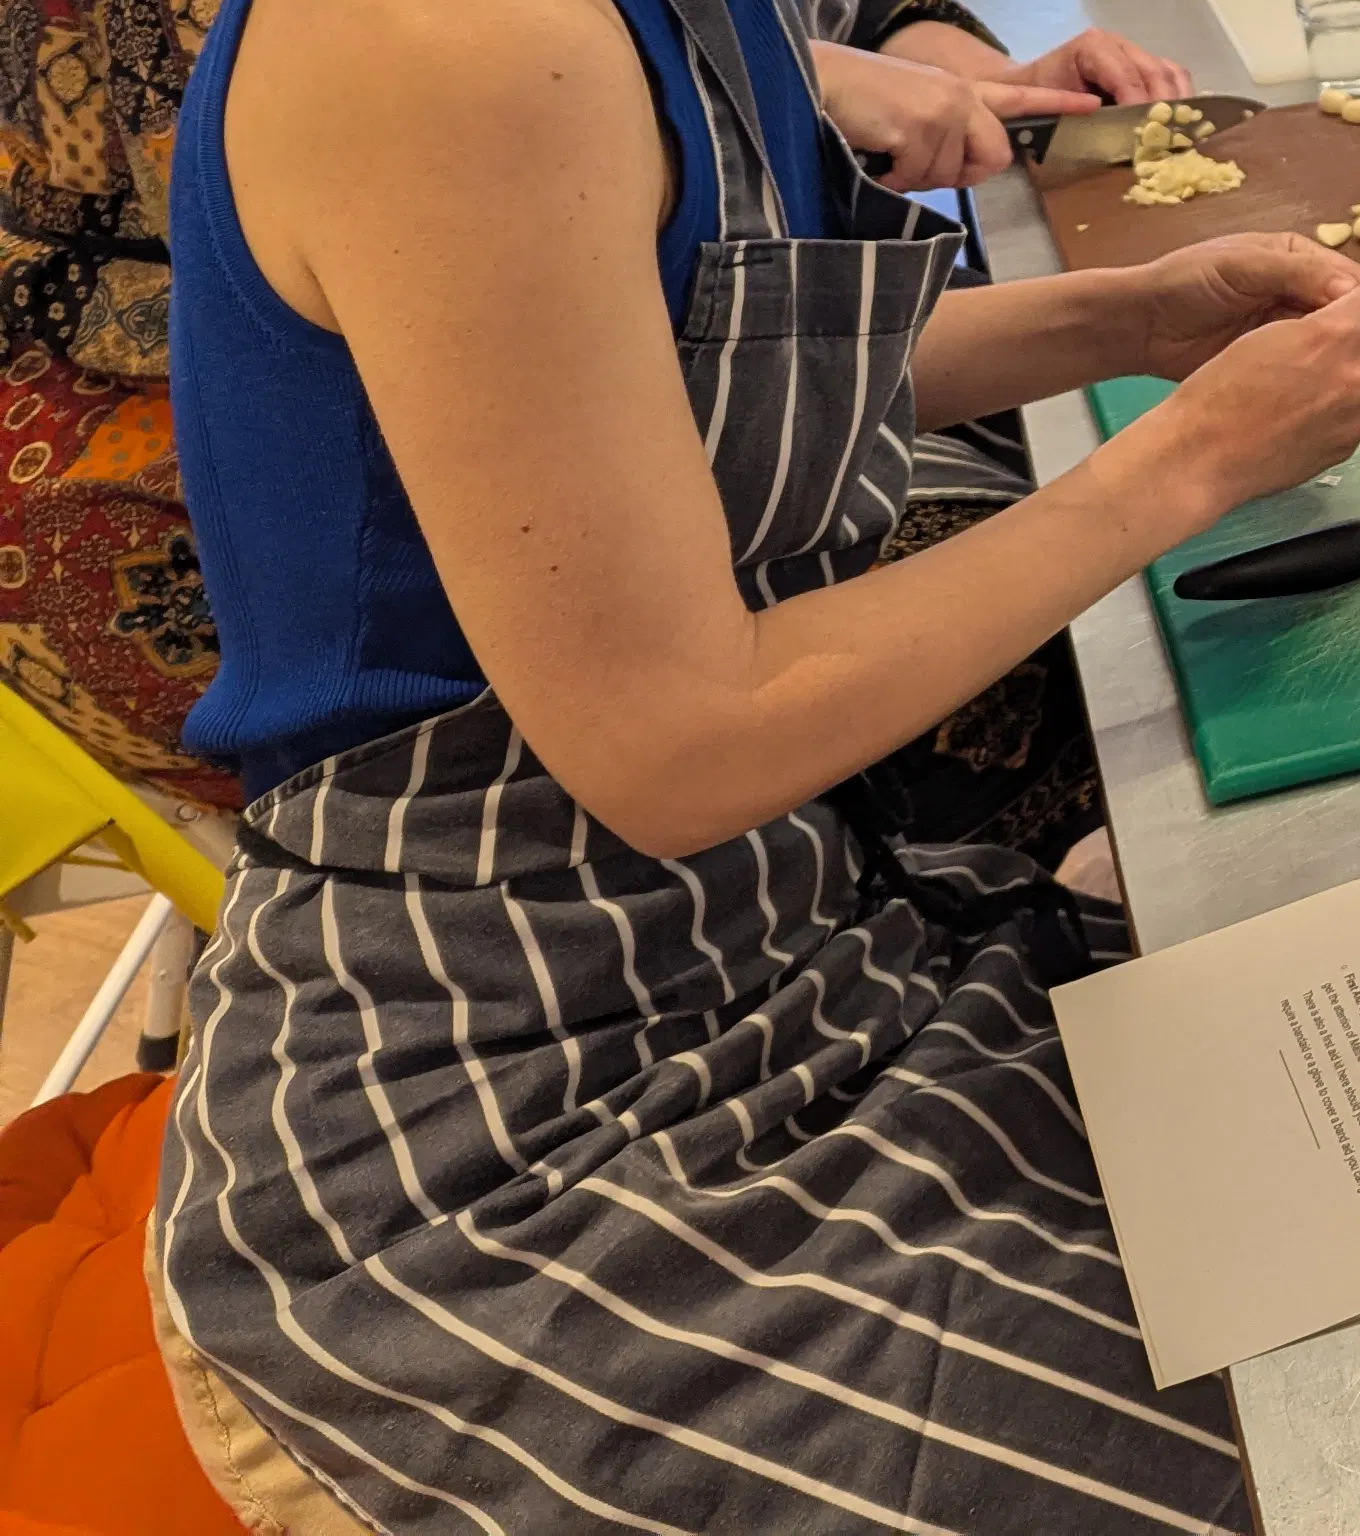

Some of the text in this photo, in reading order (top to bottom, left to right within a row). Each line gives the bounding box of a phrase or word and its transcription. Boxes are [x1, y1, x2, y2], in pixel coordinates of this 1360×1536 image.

[1344, 973, 1359, 991] First
[1303, 990, 1316, 1010] There
[1321, 983, 1335, 994] get
[1329, 993, 1338, 1005] the
[1334, 1005, 1351, 1031] attention
[1281, 999, 1295, 1021] require
[1314, 1016, 1325, 1029] also
[1323, 1034, 1335, 1049] first
[1328, 1049, 1341, 1061] aid
[1334, 1060, 1344, 1070] kit
[1308, 1068, 1324, 1088] glove
[1337, 1068, 1350, 1087] here
[1318, 1087, 1328, 1096] to
[1322, 1097, 1337, 1116] cover
[1334, 1122, 1350, 1143] band
[1342, 1143, 1355, 1155] aid
[1344, 1155, 1359, 1171] you
